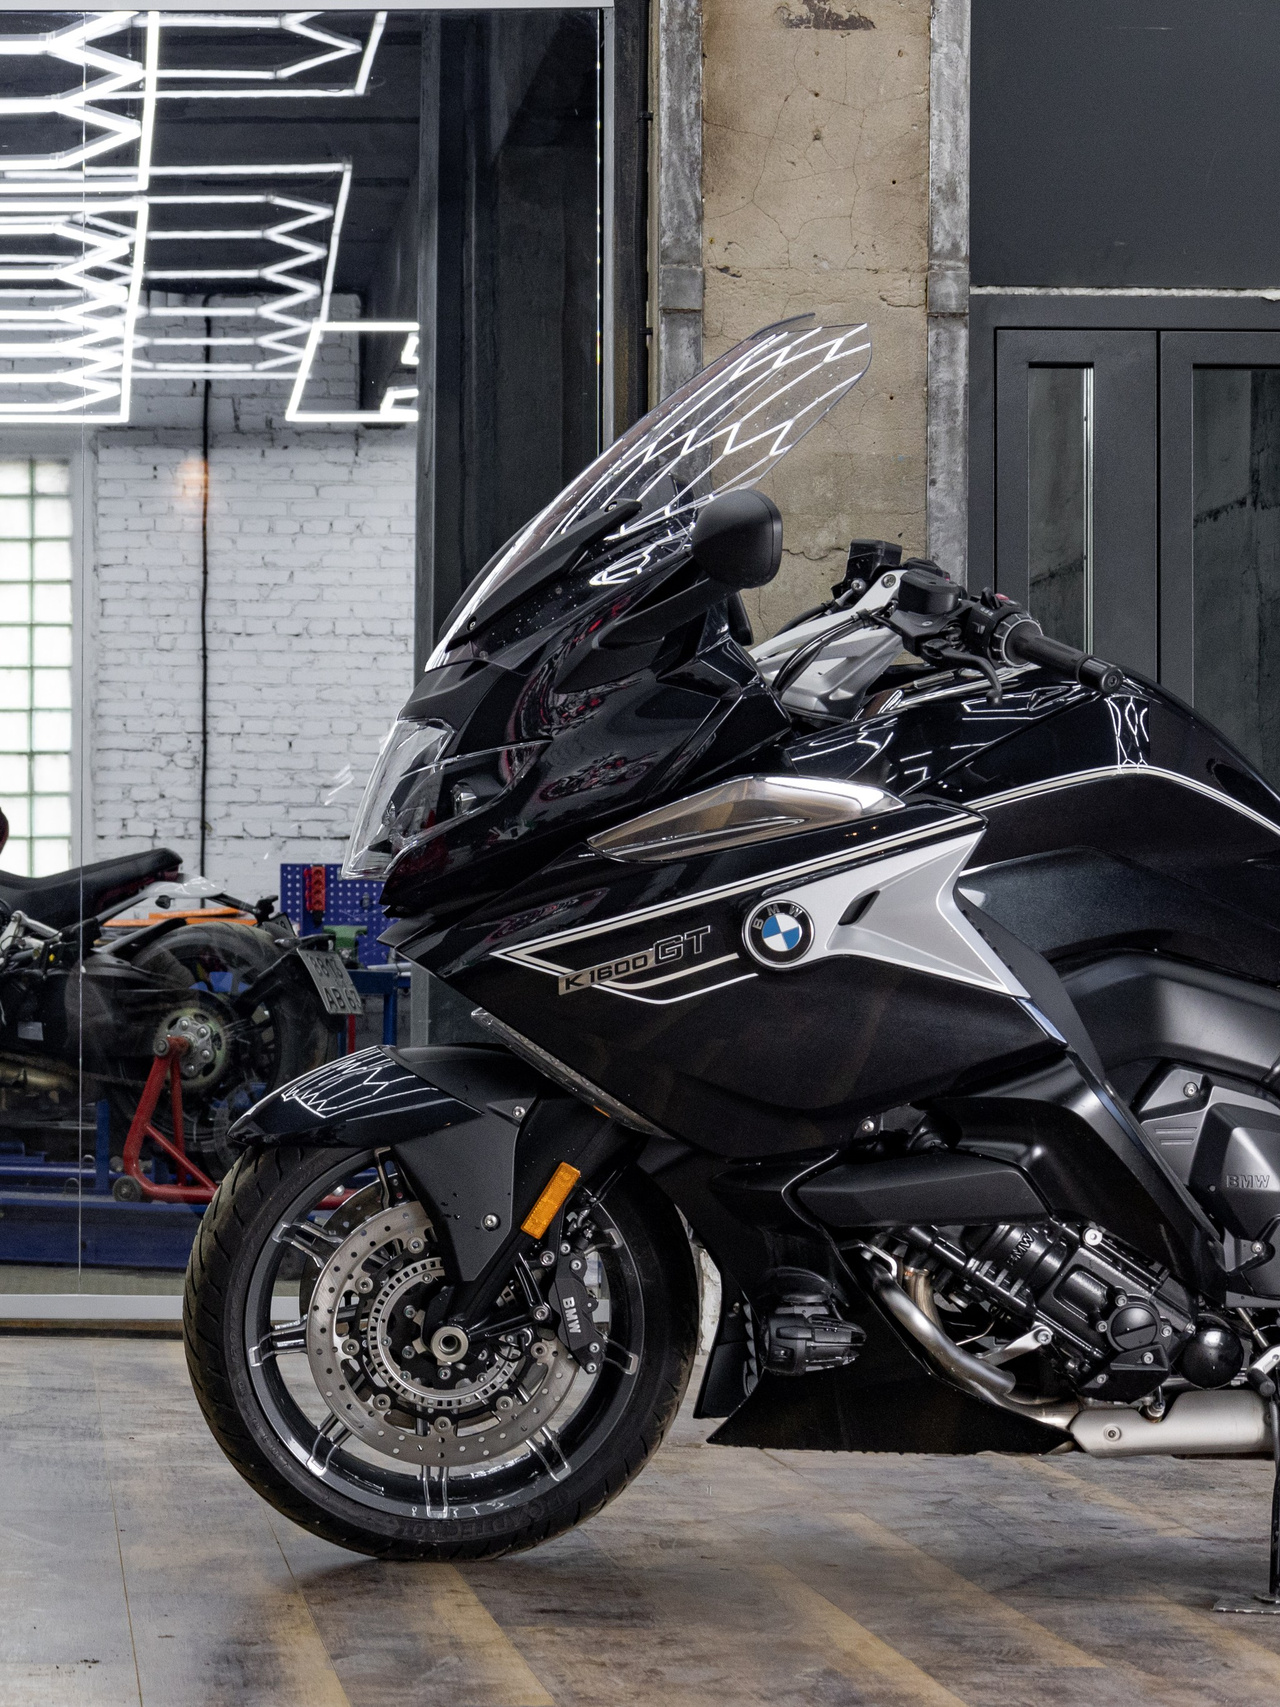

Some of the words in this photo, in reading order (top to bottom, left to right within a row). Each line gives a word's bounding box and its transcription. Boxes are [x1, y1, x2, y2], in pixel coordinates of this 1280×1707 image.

[752, 904, 803, 930] BMW
[565, 976, 583, 991] K
[588, 956, 648, 983] 1600
[654, 925, 711, 965] GT
[1225, 1174, 1272, 1189] BMW
[1006, 1229, 1035, 1267] BMW
[562, 1296, 582, 1334] BMW
